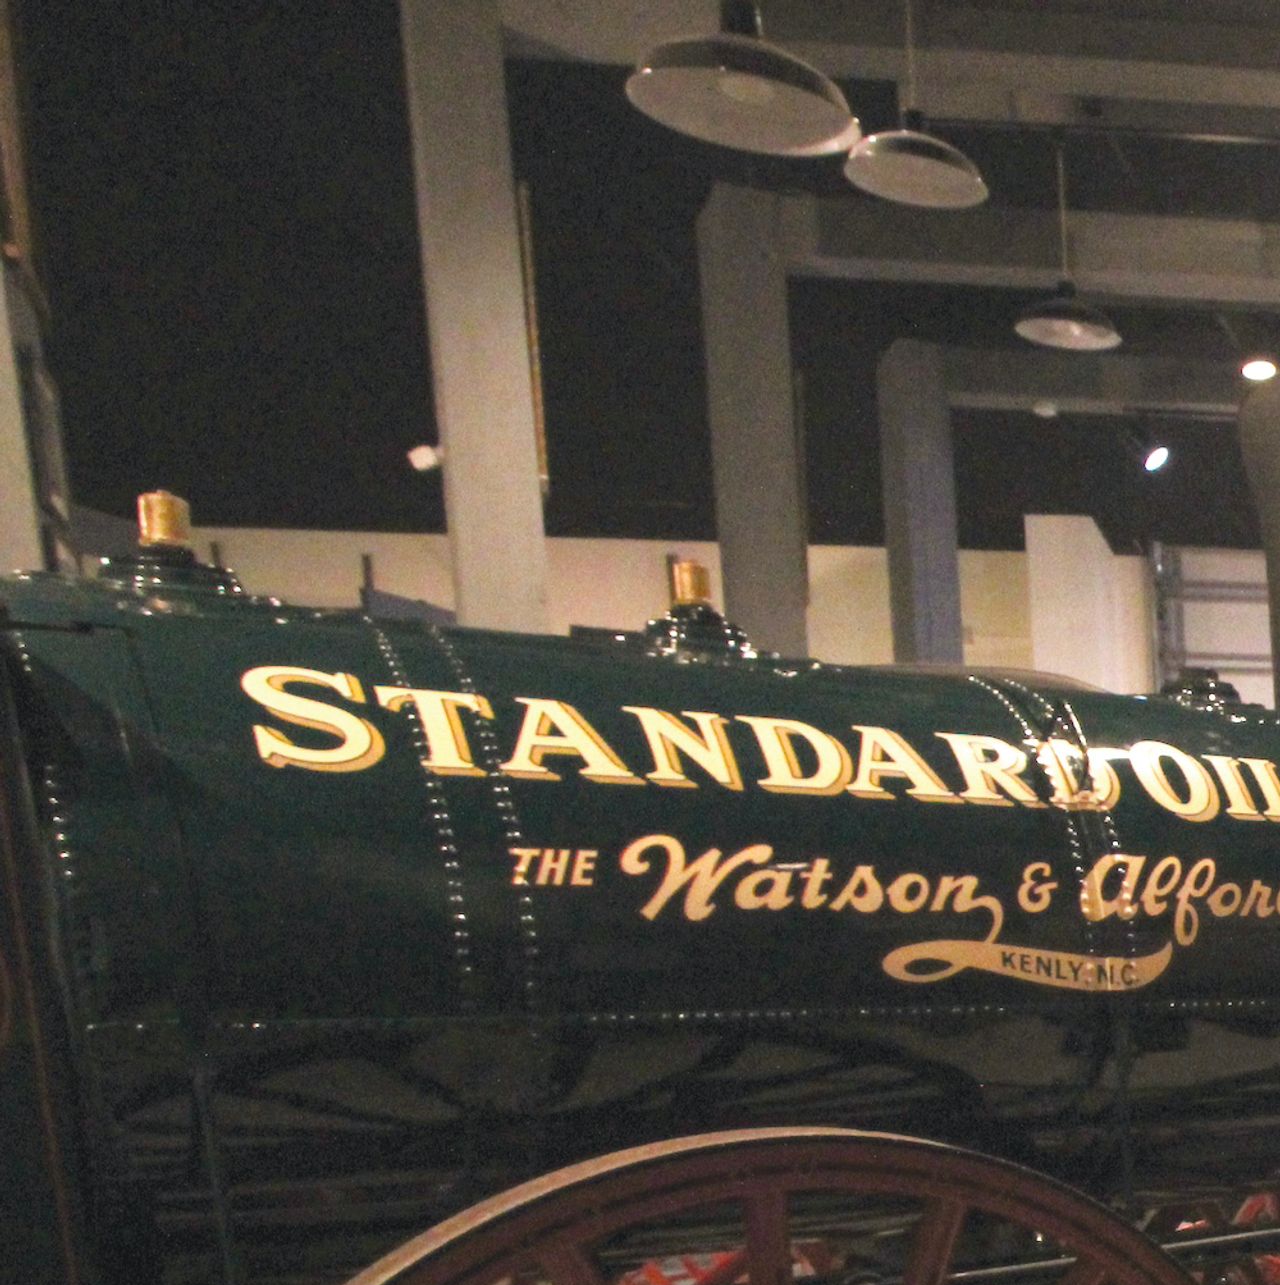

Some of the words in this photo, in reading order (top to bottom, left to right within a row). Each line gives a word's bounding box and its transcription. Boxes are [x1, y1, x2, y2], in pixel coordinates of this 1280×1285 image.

[241, 665, 1120, 811] STANDARD
[508, 848, 598, 886] THE
[619, 834, 1004, 940] Watson
[1017, 862, 1058, 912] &
